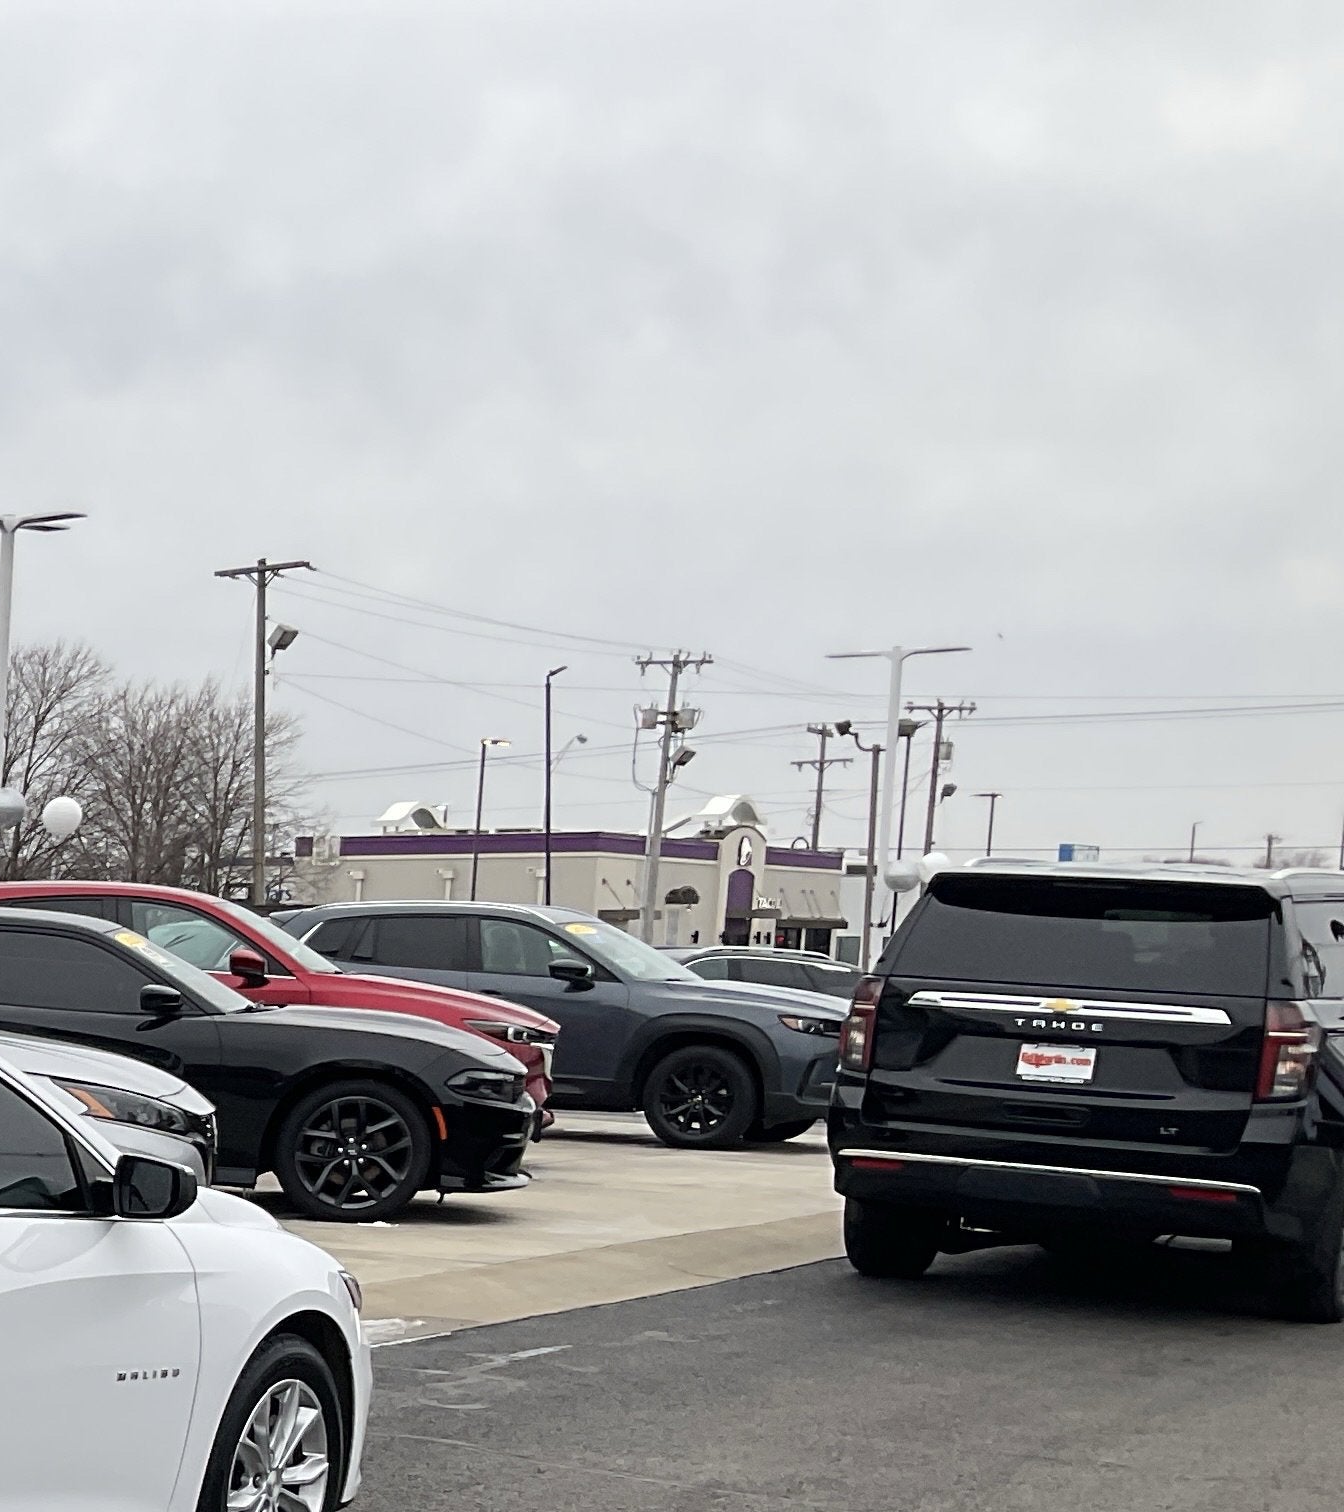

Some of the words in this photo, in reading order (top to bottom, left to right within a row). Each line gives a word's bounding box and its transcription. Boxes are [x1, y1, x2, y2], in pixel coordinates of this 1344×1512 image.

[1014, 1018, 1104, 1032] TAHOE
[1159, 1126, 1180, 1136] LT
[116, 1367, 181, 1382] MALIBU
